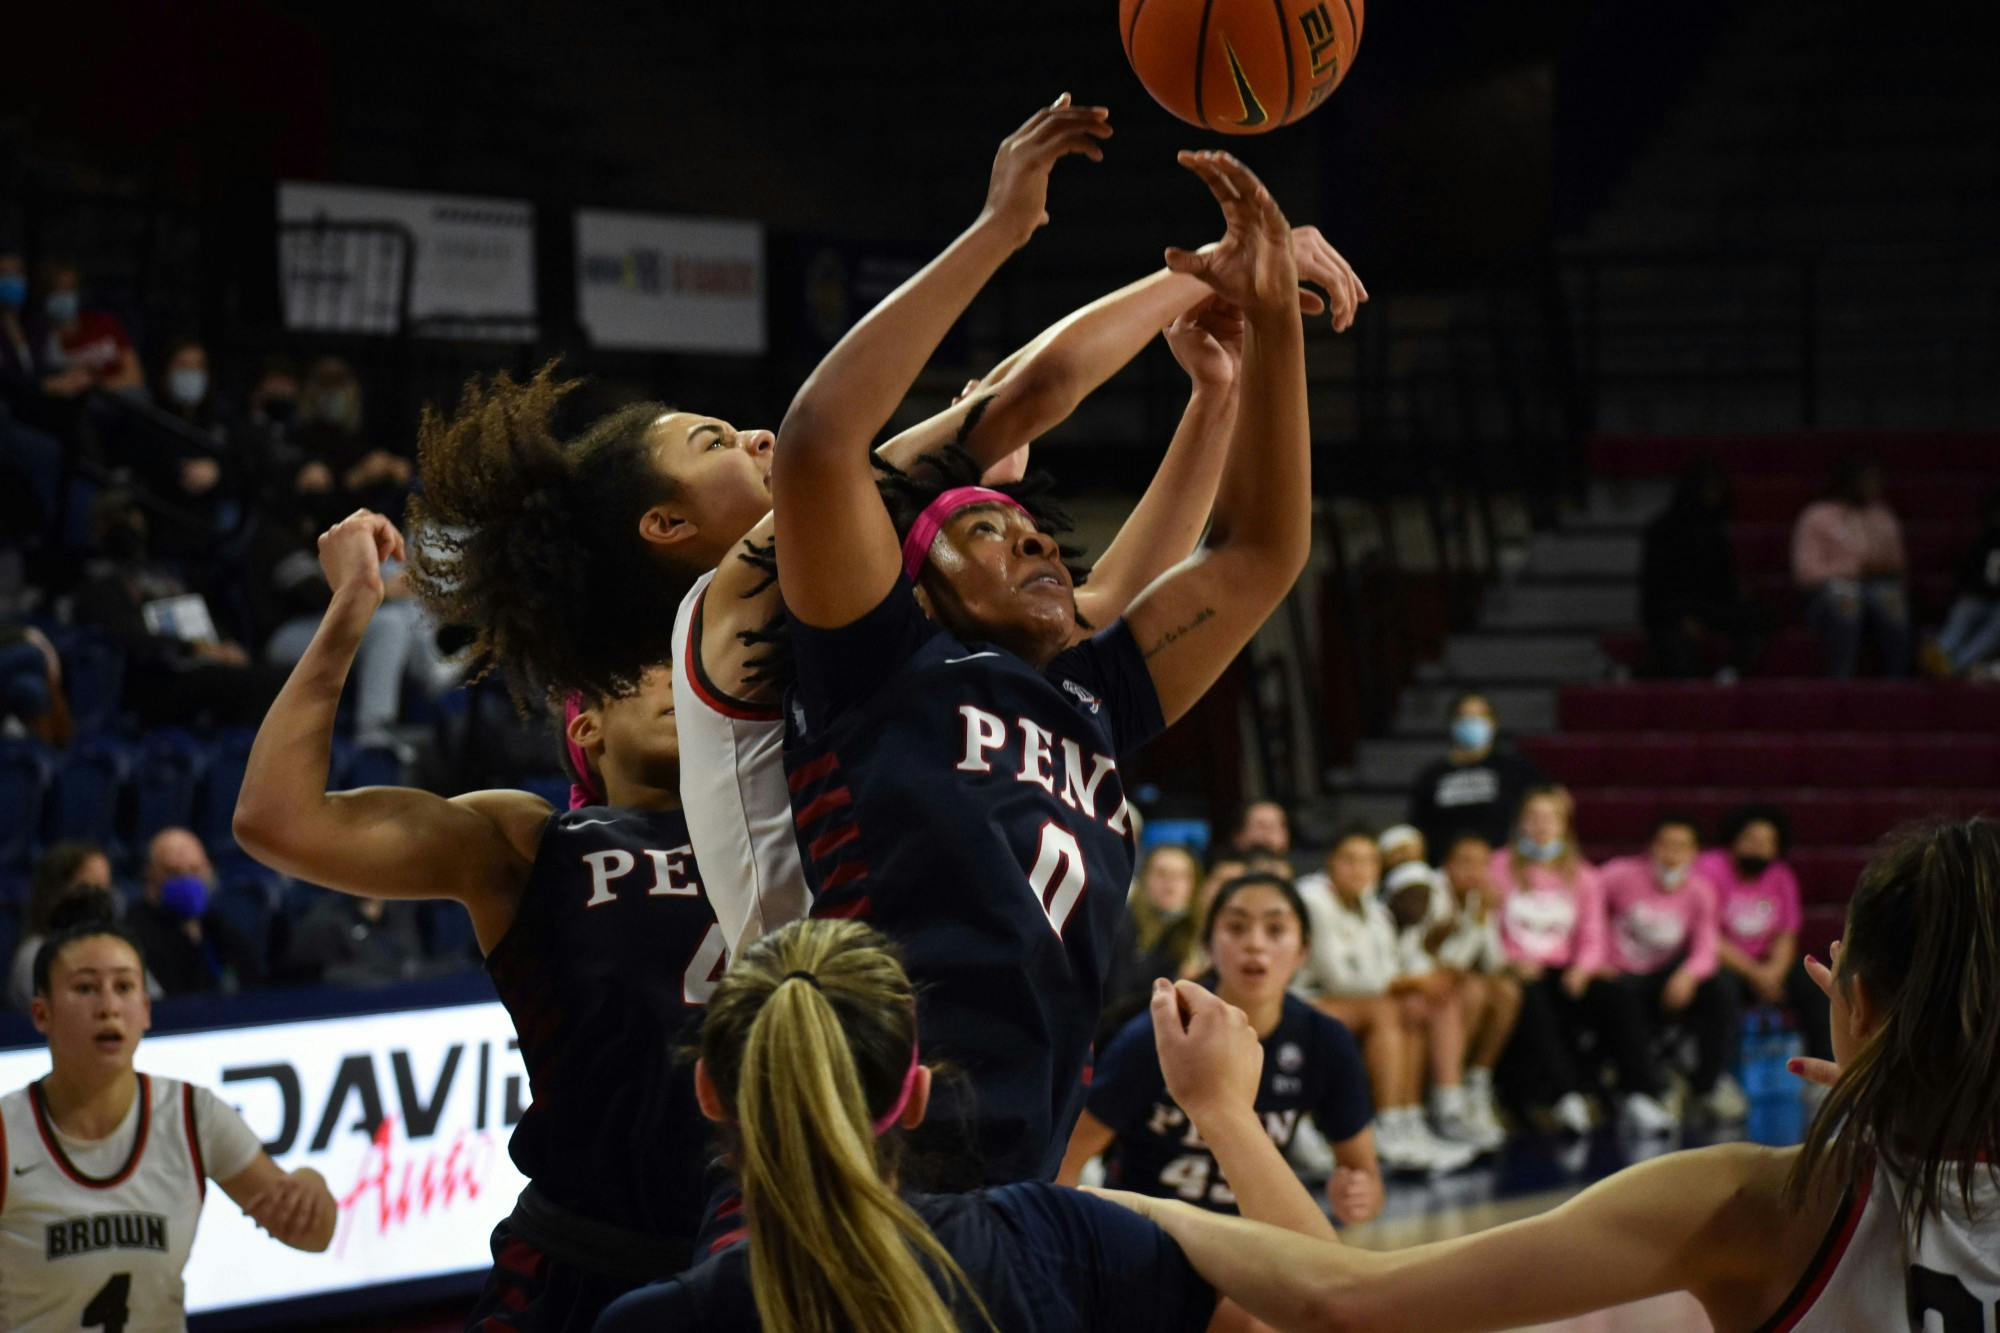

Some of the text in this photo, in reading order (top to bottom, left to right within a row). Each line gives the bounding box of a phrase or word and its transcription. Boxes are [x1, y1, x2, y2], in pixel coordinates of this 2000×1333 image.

[581, 843, 700, 908] PE
[1028, 819, 1086, 942] 0
[46, 1212, 169, 1261] BROWN
[80, 1273, 132, 1333] 4
